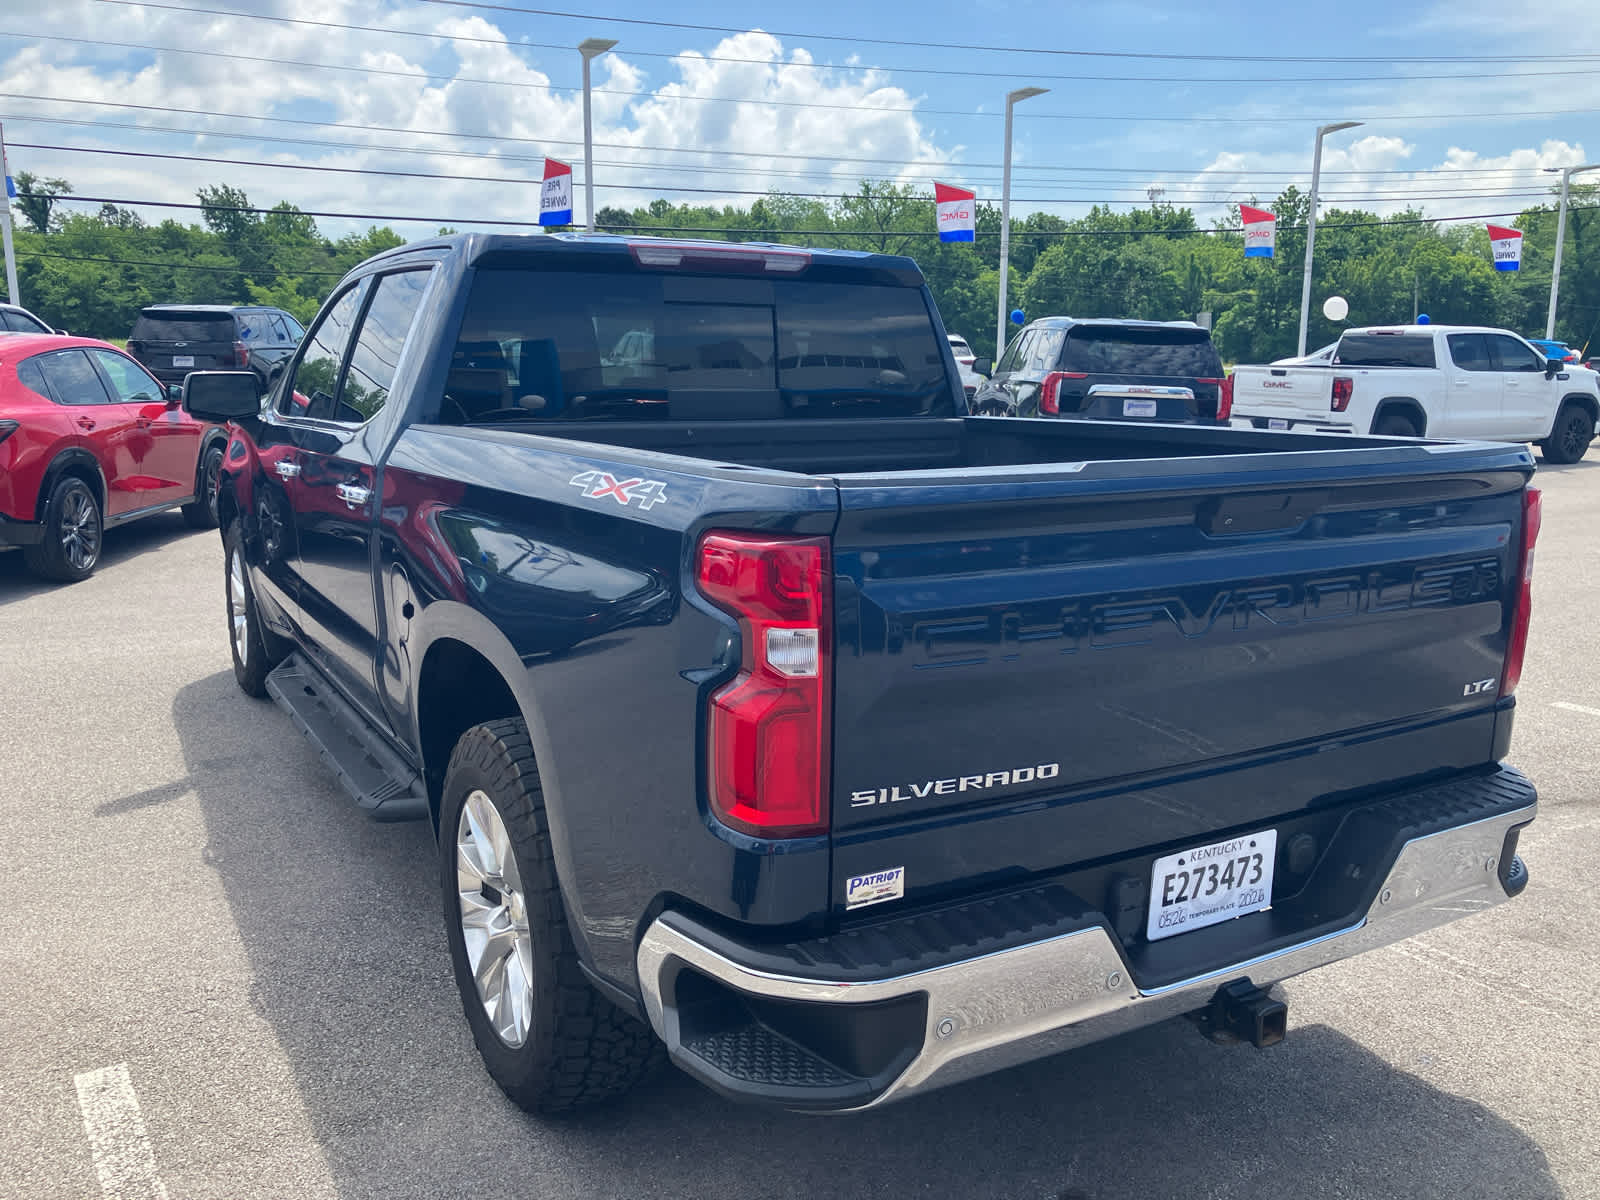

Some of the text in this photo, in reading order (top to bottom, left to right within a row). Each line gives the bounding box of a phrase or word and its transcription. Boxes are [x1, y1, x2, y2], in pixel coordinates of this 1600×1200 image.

[1263, 381, 1293, 389] GMC
[1463, 678, 1496, 697] LTZ
[850, 763, 1059, 807] SILVERADO
[1190, 840, 1244, 862] KENTUCKY
[848, 869, 902, 896] PATRIOT
[1161, 852, 1264, 908] E273473
[1189, 903, 1235, 918] TEMPORARY PLATE
